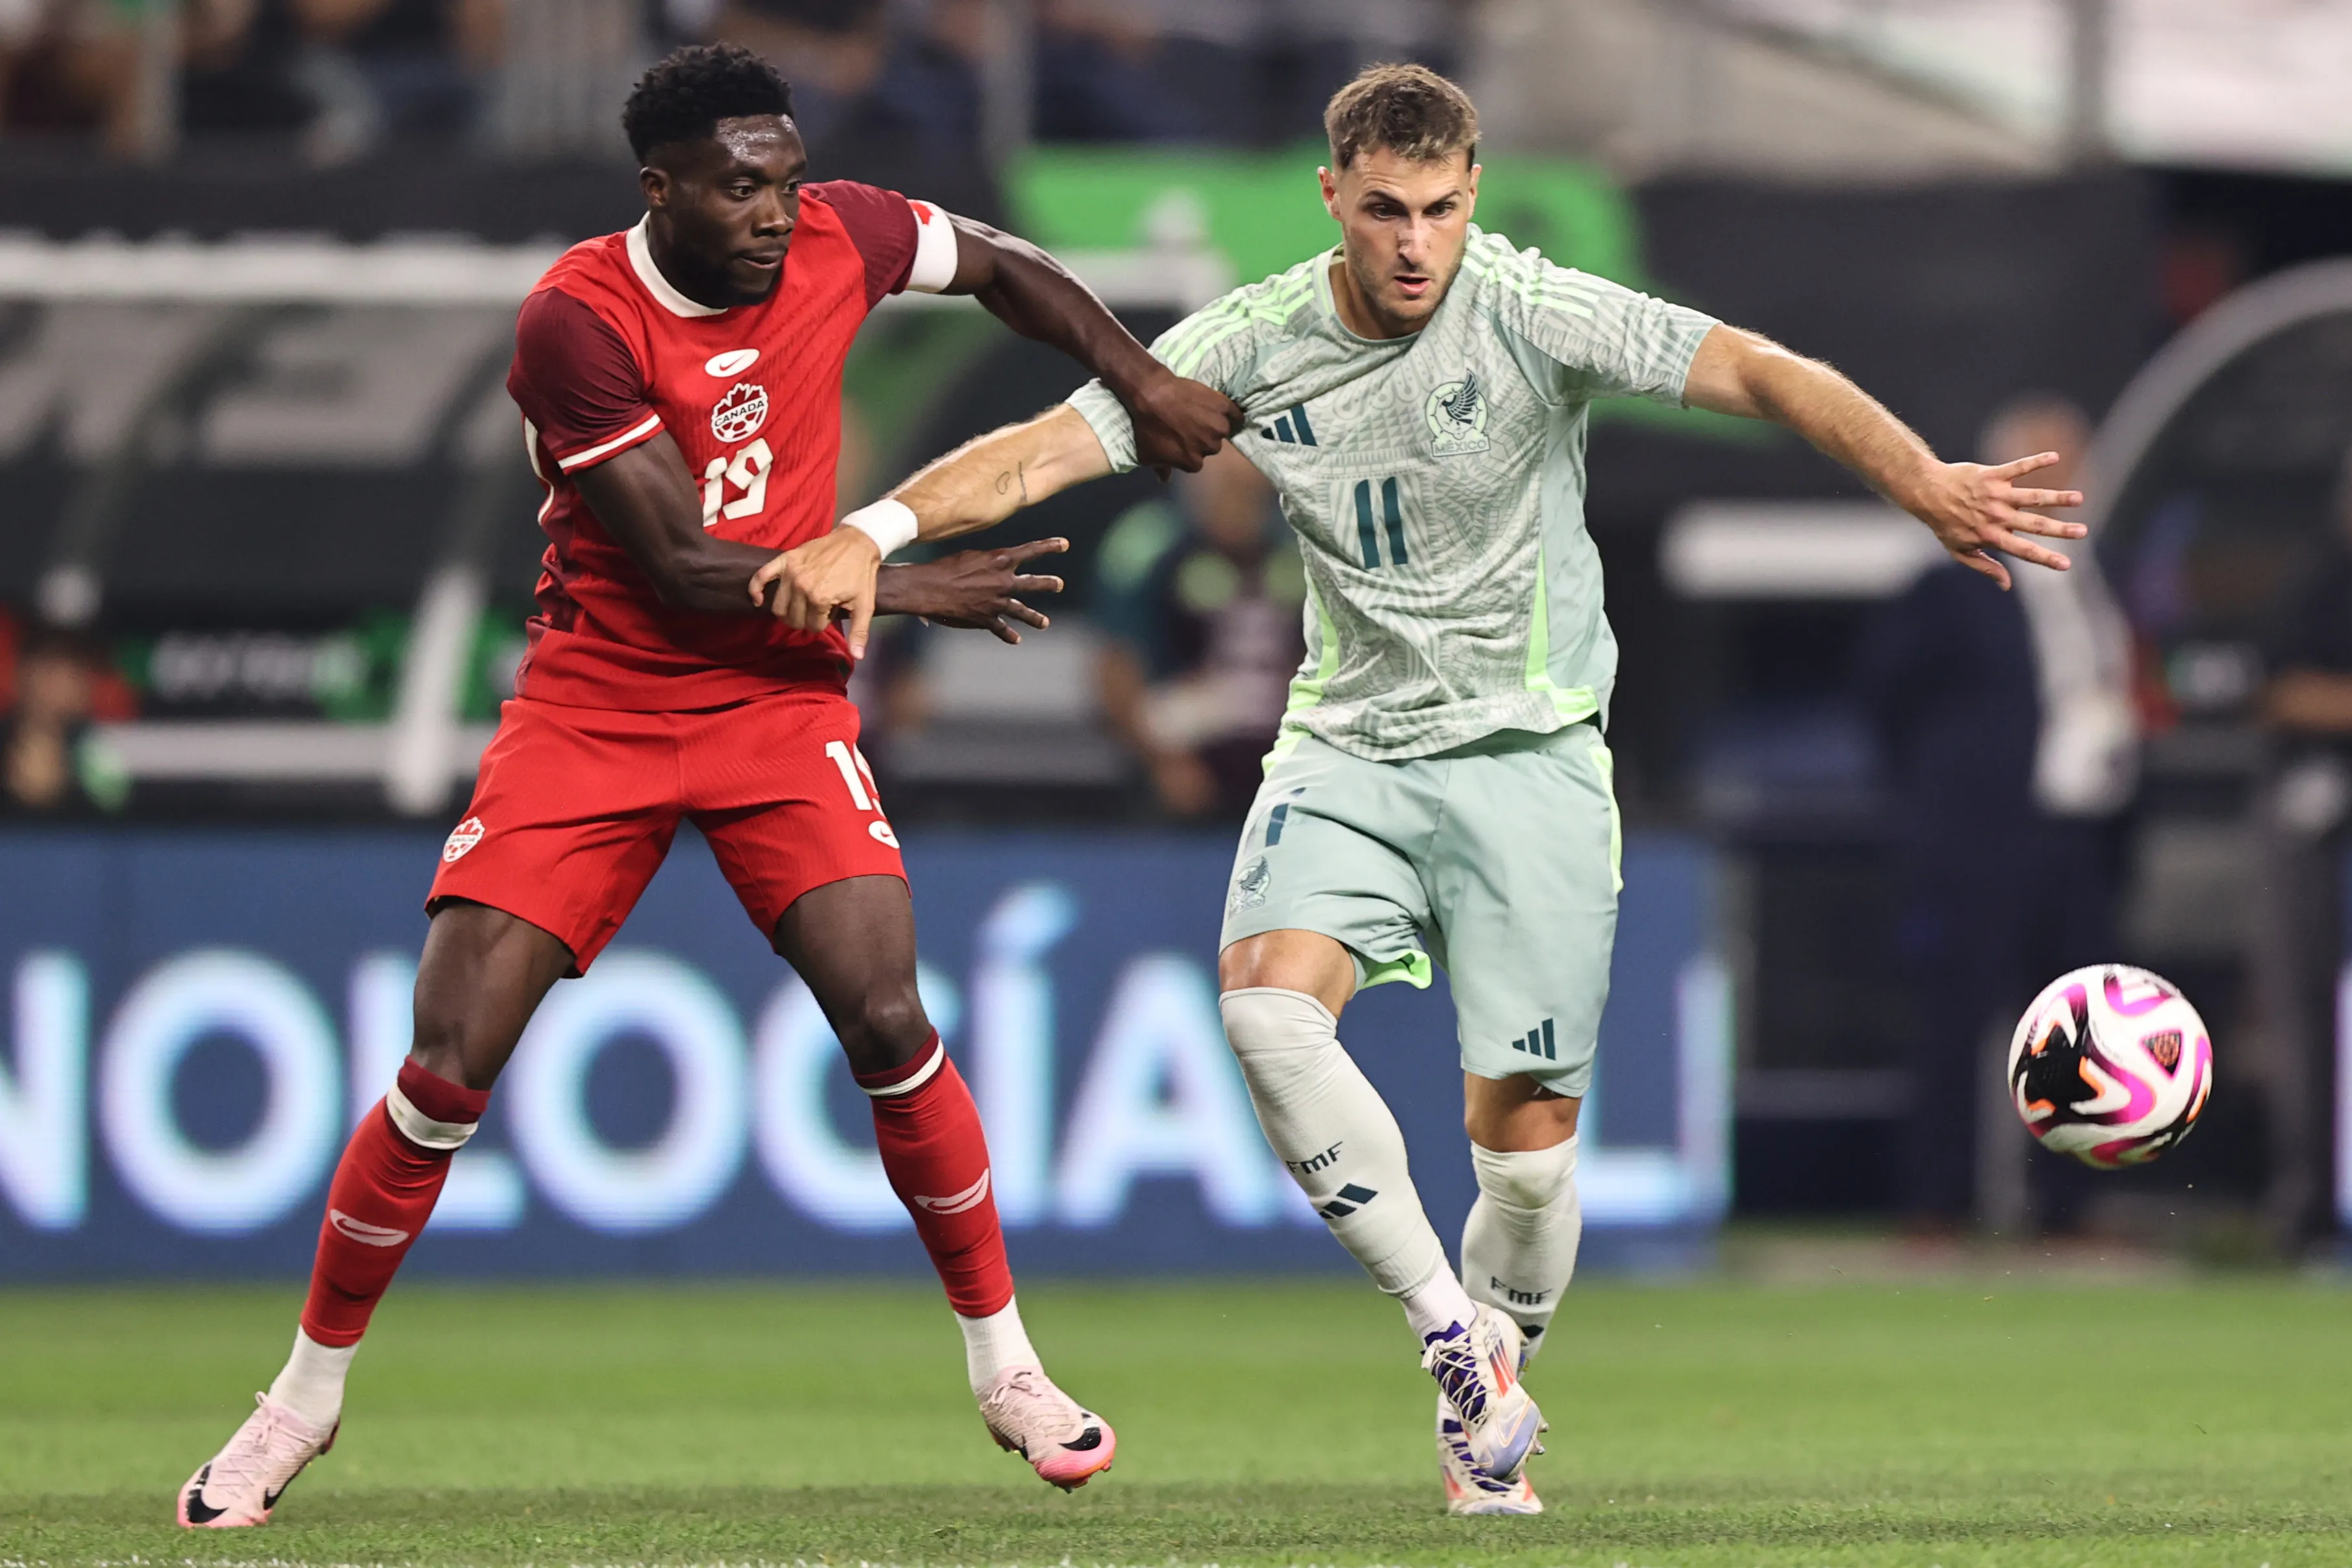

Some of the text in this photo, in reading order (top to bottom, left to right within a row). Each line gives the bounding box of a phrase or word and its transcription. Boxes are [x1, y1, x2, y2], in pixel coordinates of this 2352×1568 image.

[714, 400, 765, 427] CANADA
[1434, 440, 1487, 454] MÉXICO
[703, 437, 774, 527] 19
[1354, 476, 1408, 569] 11
